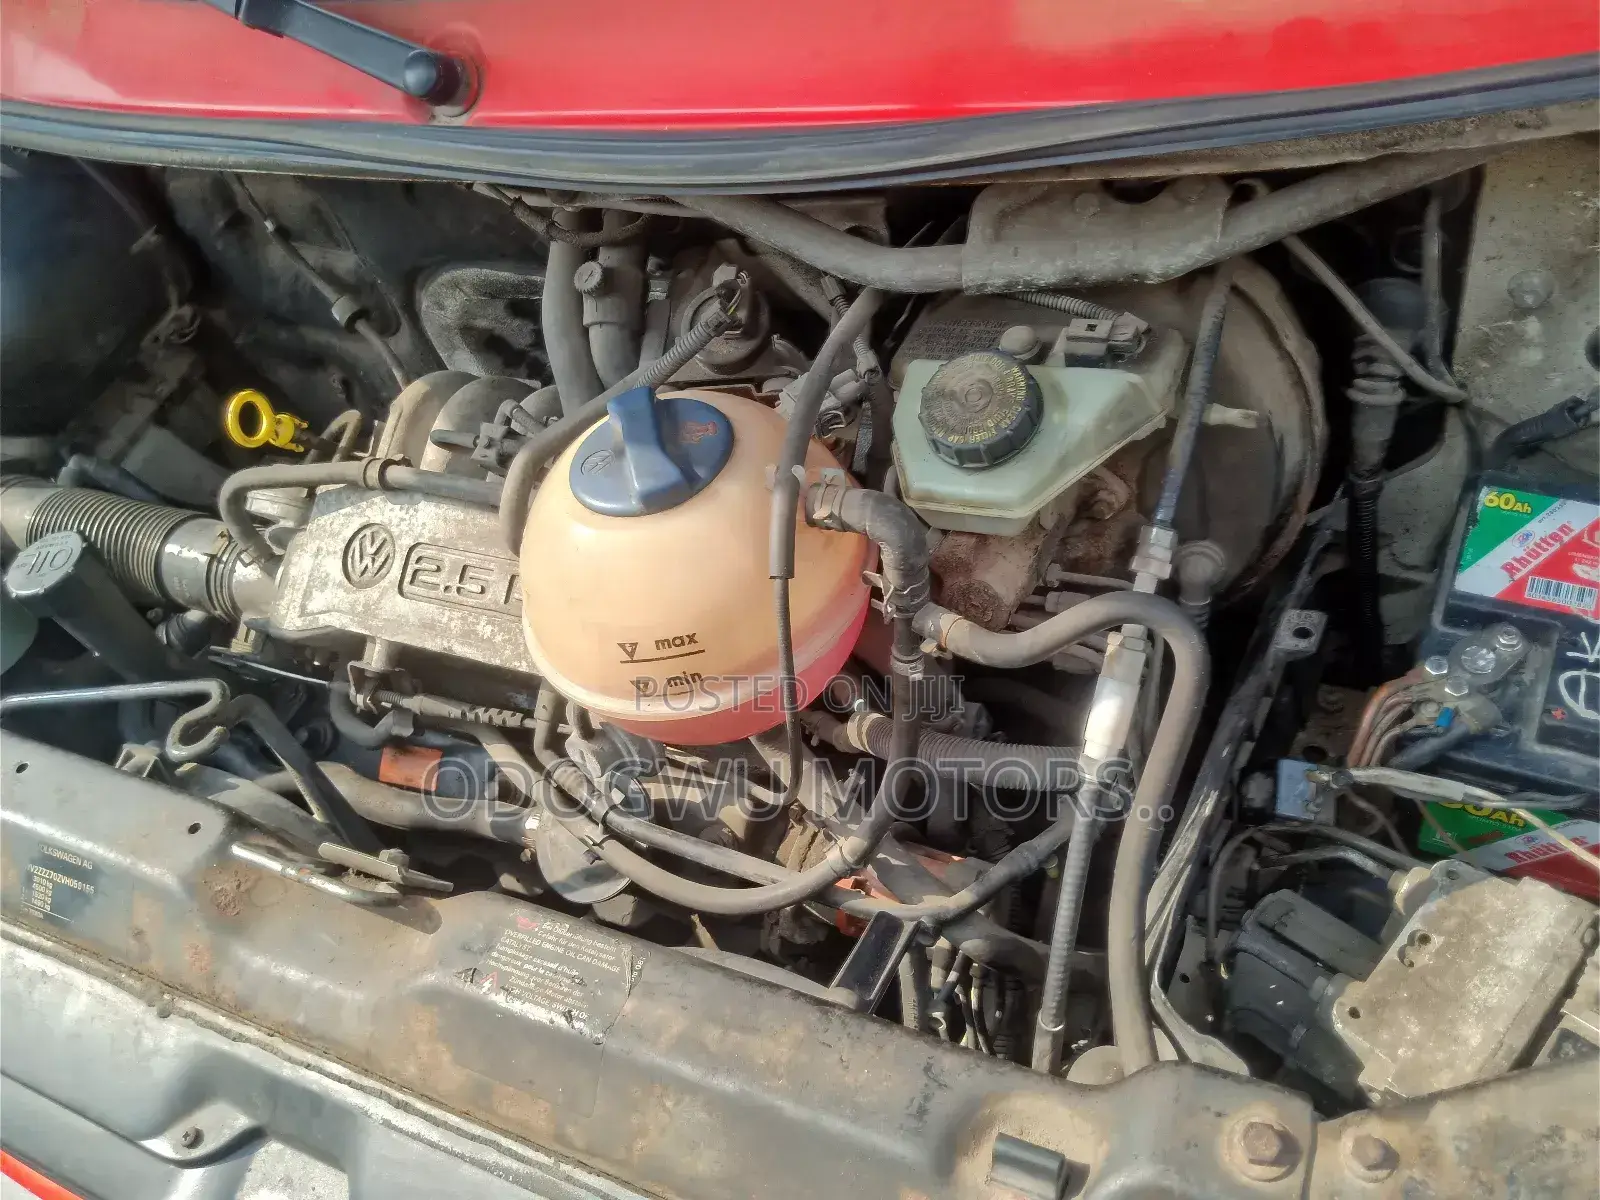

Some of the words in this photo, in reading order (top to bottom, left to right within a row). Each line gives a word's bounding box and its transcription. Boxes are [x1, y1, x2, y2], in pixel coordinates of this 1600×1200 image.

[1011, 365, 1026, 400] WARNING
[1484, 491, 1532, 514] 60Ah
[1500, 523, 1575, 580] Rhütten
[409, 555, 491, 597] 2.5
[655, 631, 698, 651] max
[666, 670, 704, 688] min
[82, 860, 93, 870] AG
[505, 929, 541, 946] OVERFILLED
[542, 940, 564, 954] ENGINE
[565, 949, 576, 958] OIL
[576, 953, 591, 963] CAN
[592, 958, 620, 974] DAMAGE
